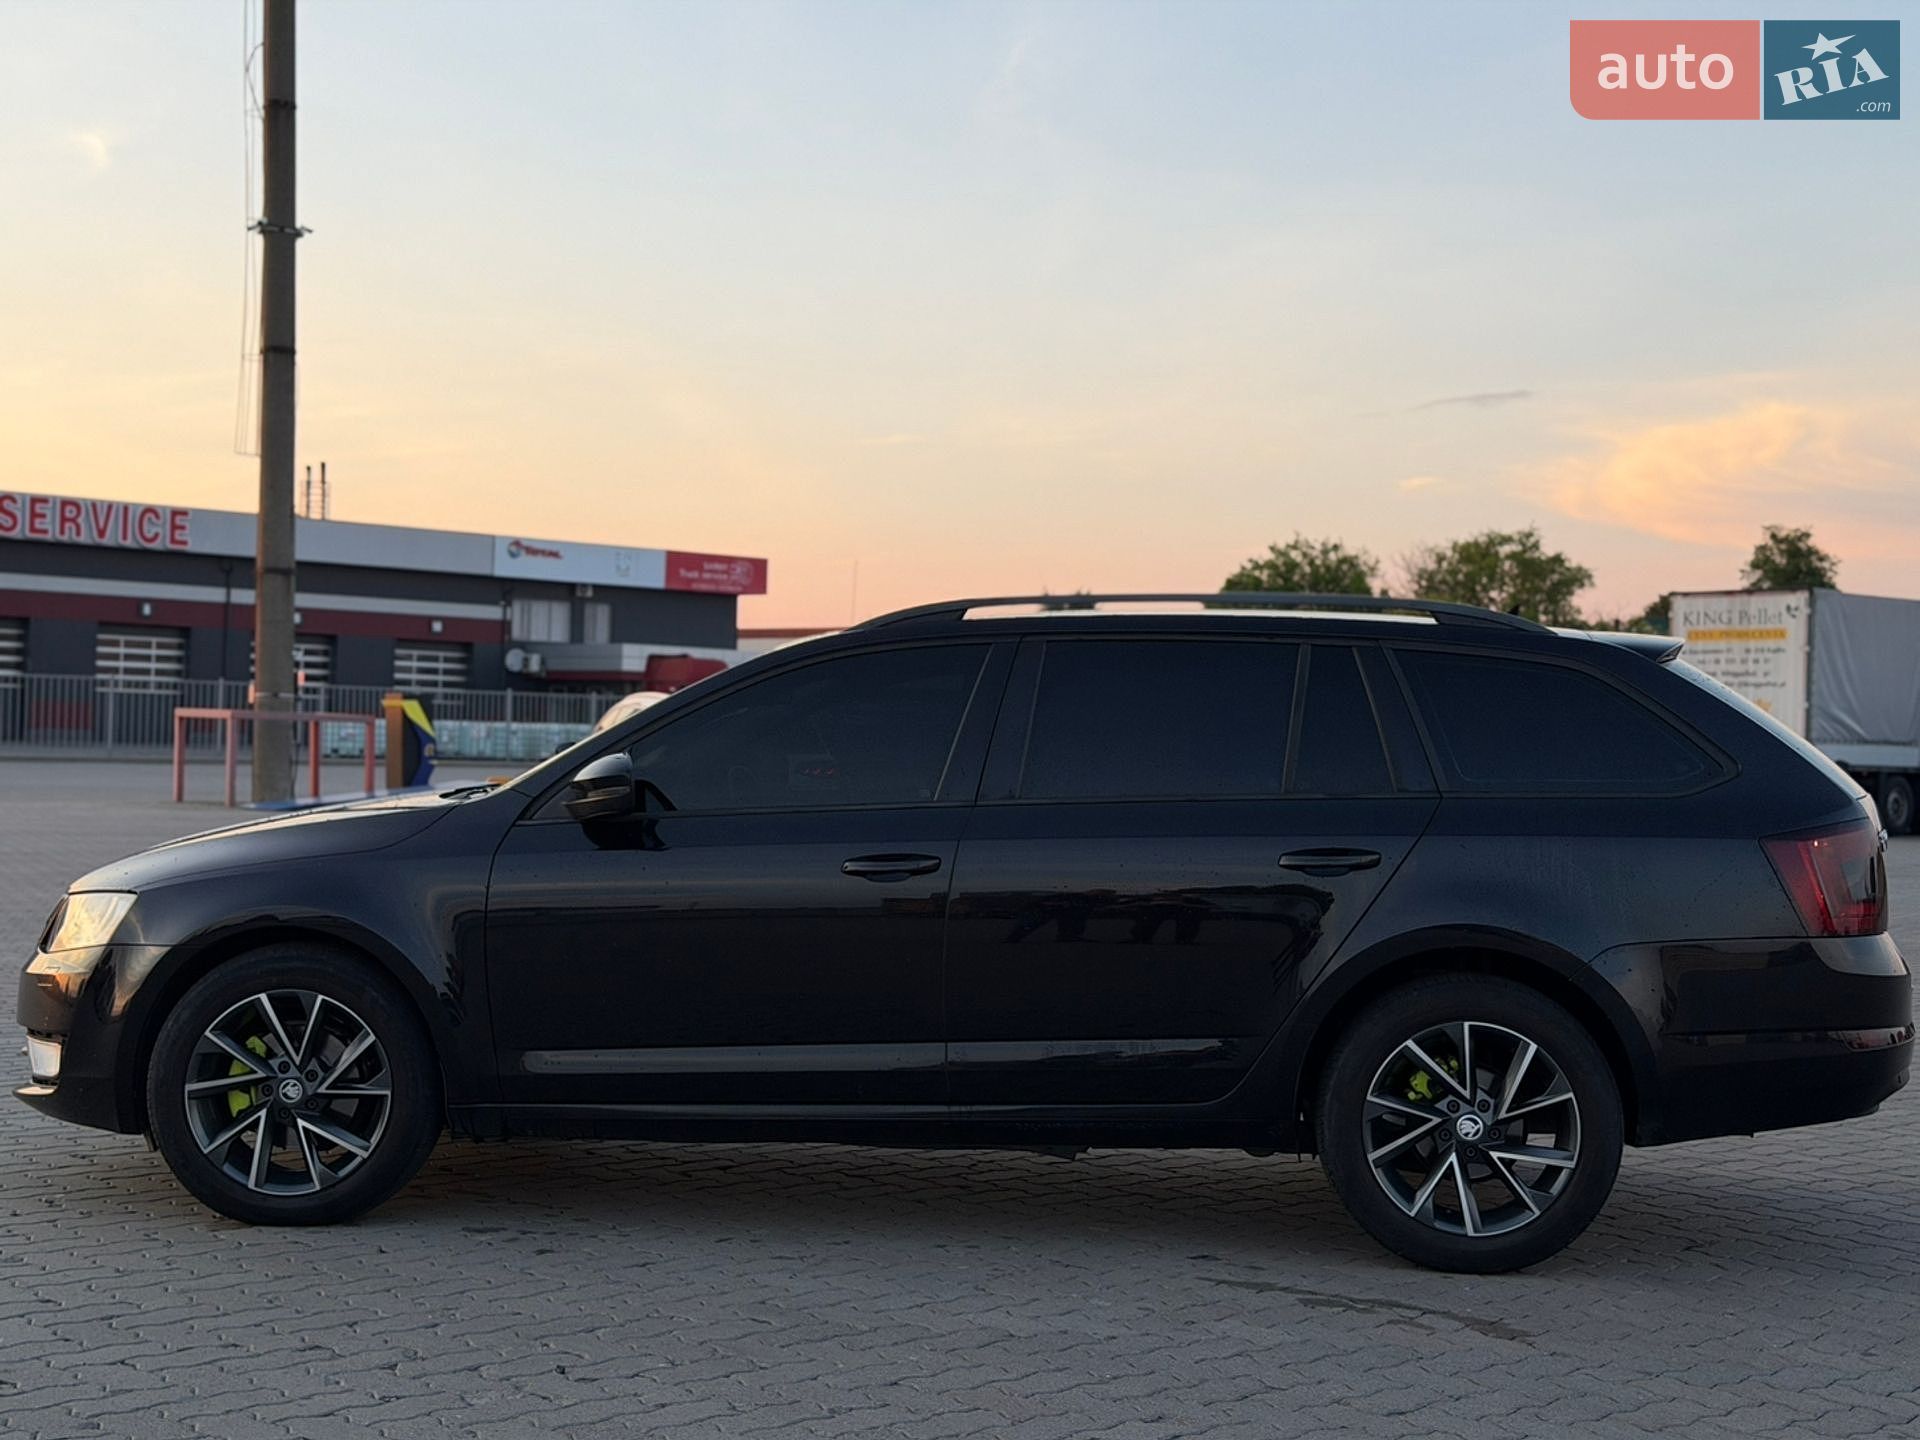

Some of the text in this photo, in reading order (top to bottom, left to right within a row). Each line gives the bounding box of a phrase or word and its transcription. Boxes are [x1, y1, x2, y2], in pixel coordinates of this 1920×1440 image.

[0, 493, 191, 548] SERVICE
[1683, 607, 1783, 627] KING Pellet
